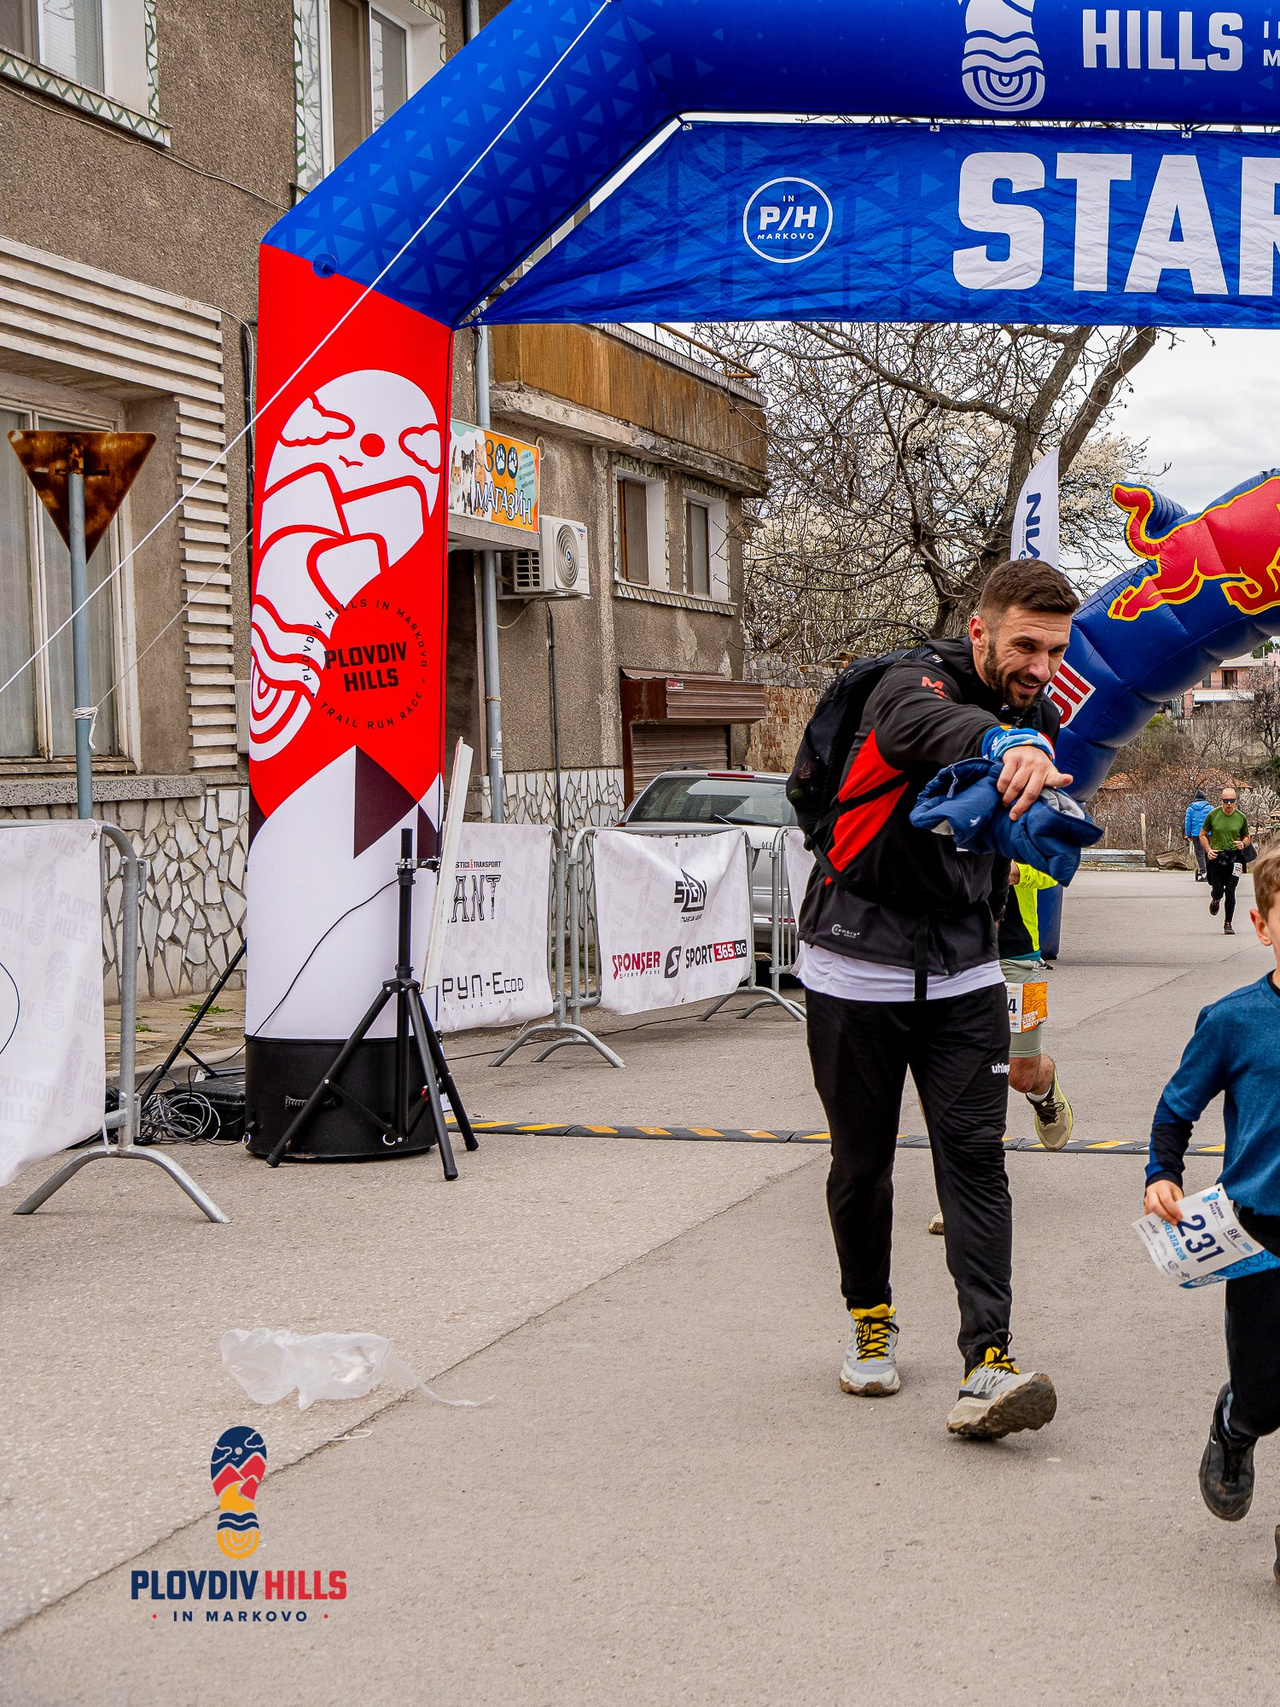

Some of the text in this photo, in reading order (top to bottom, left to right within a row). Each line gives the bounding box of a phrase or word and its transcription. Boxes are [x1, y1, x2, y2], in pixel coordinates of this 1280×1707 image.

[1082, 9, 1243, 72] HILLS
[783, 195, 795, 203] IN
[759, 206, 817, 231] P/H
[757, 232, 815, 240] MARKOVO
[475, 481, 532, 525] МАГАЗИН
[302, 599, 427, 681] PLOVDIV HILLS IN MARKOVO
[324, 641, 407, 670] PLOVDIV
[343, 668, 399, 692] HILLS
[320, 692, 422, 729] TRAIL RUN RACE
[450, 874, 502, 924] ANT
[611, 951, 661, 980] SPONSER
[1177, 1214, 1225, 1263] 231
[1227, 1228, 1242, 1241] 8K
[1175, 1246, 1188, 1261] RUN
